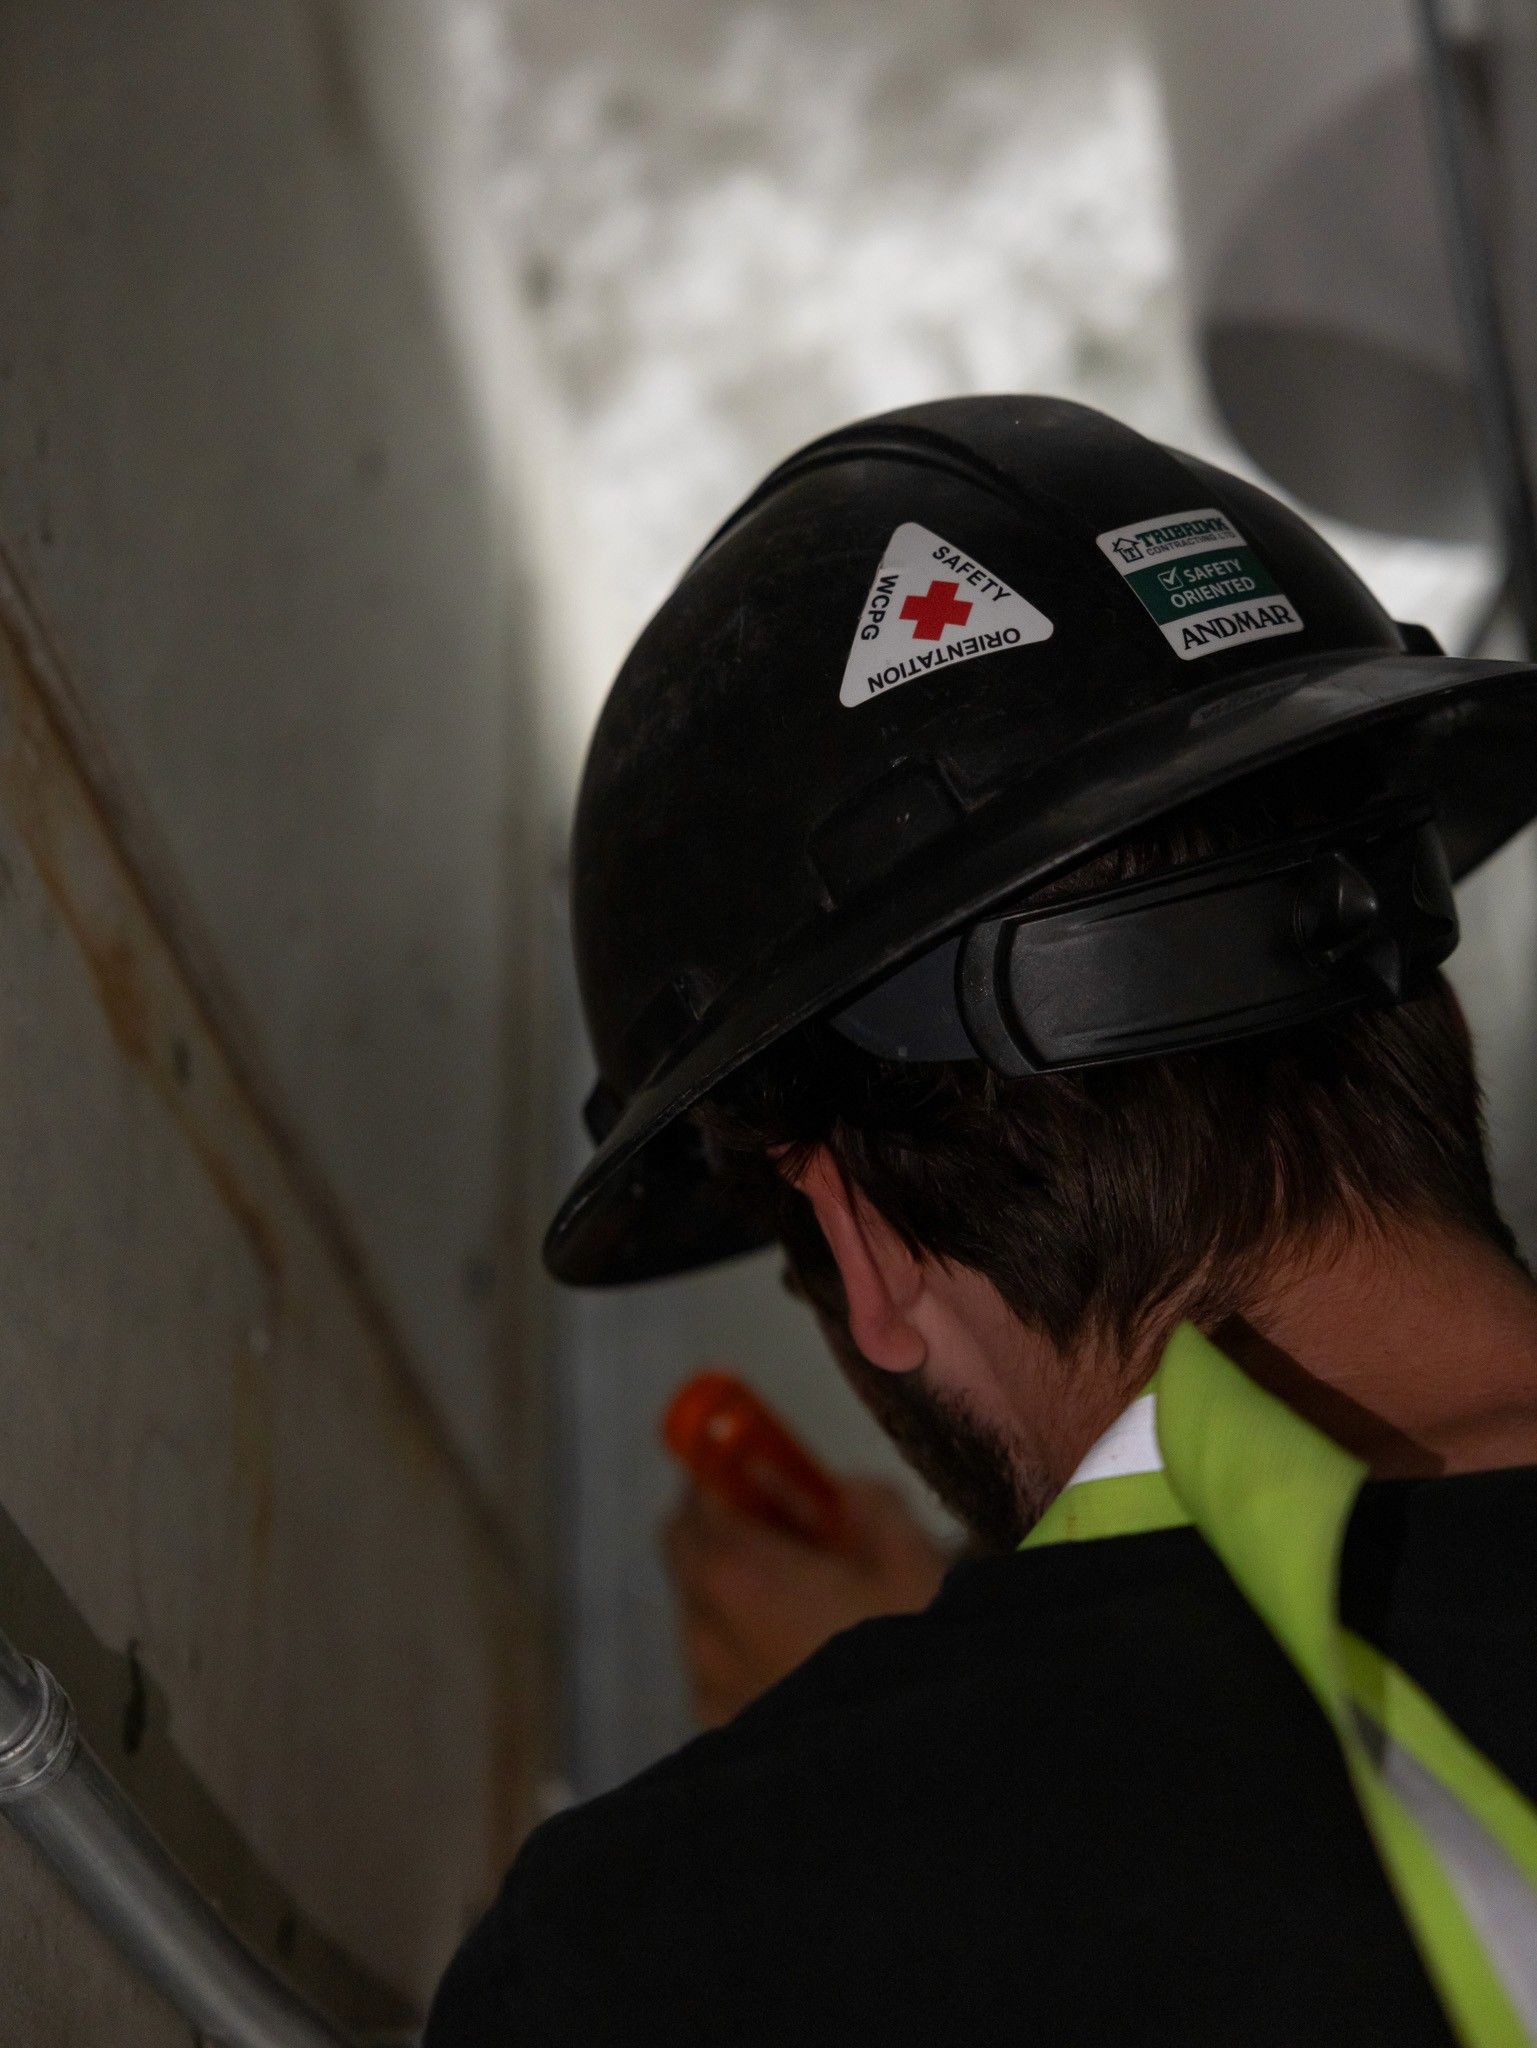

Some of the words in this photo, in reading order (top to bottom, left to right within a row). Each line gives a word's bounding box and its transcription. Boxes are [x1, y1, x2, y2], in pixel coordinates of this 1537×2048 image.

[1146, 533, 1216, 556] CONTRACTING
[932, 546, 1011, 602] SAFETY
[1170, 576, 1256, 608] ORIENTED
[1183, 558, 1243, 583] SAFETY
[860, 574, 899, 641] WCPG
[1181, 604, 1295, 650] ANDMAR
[867, 627, 1021, 693] ORIENTATION
